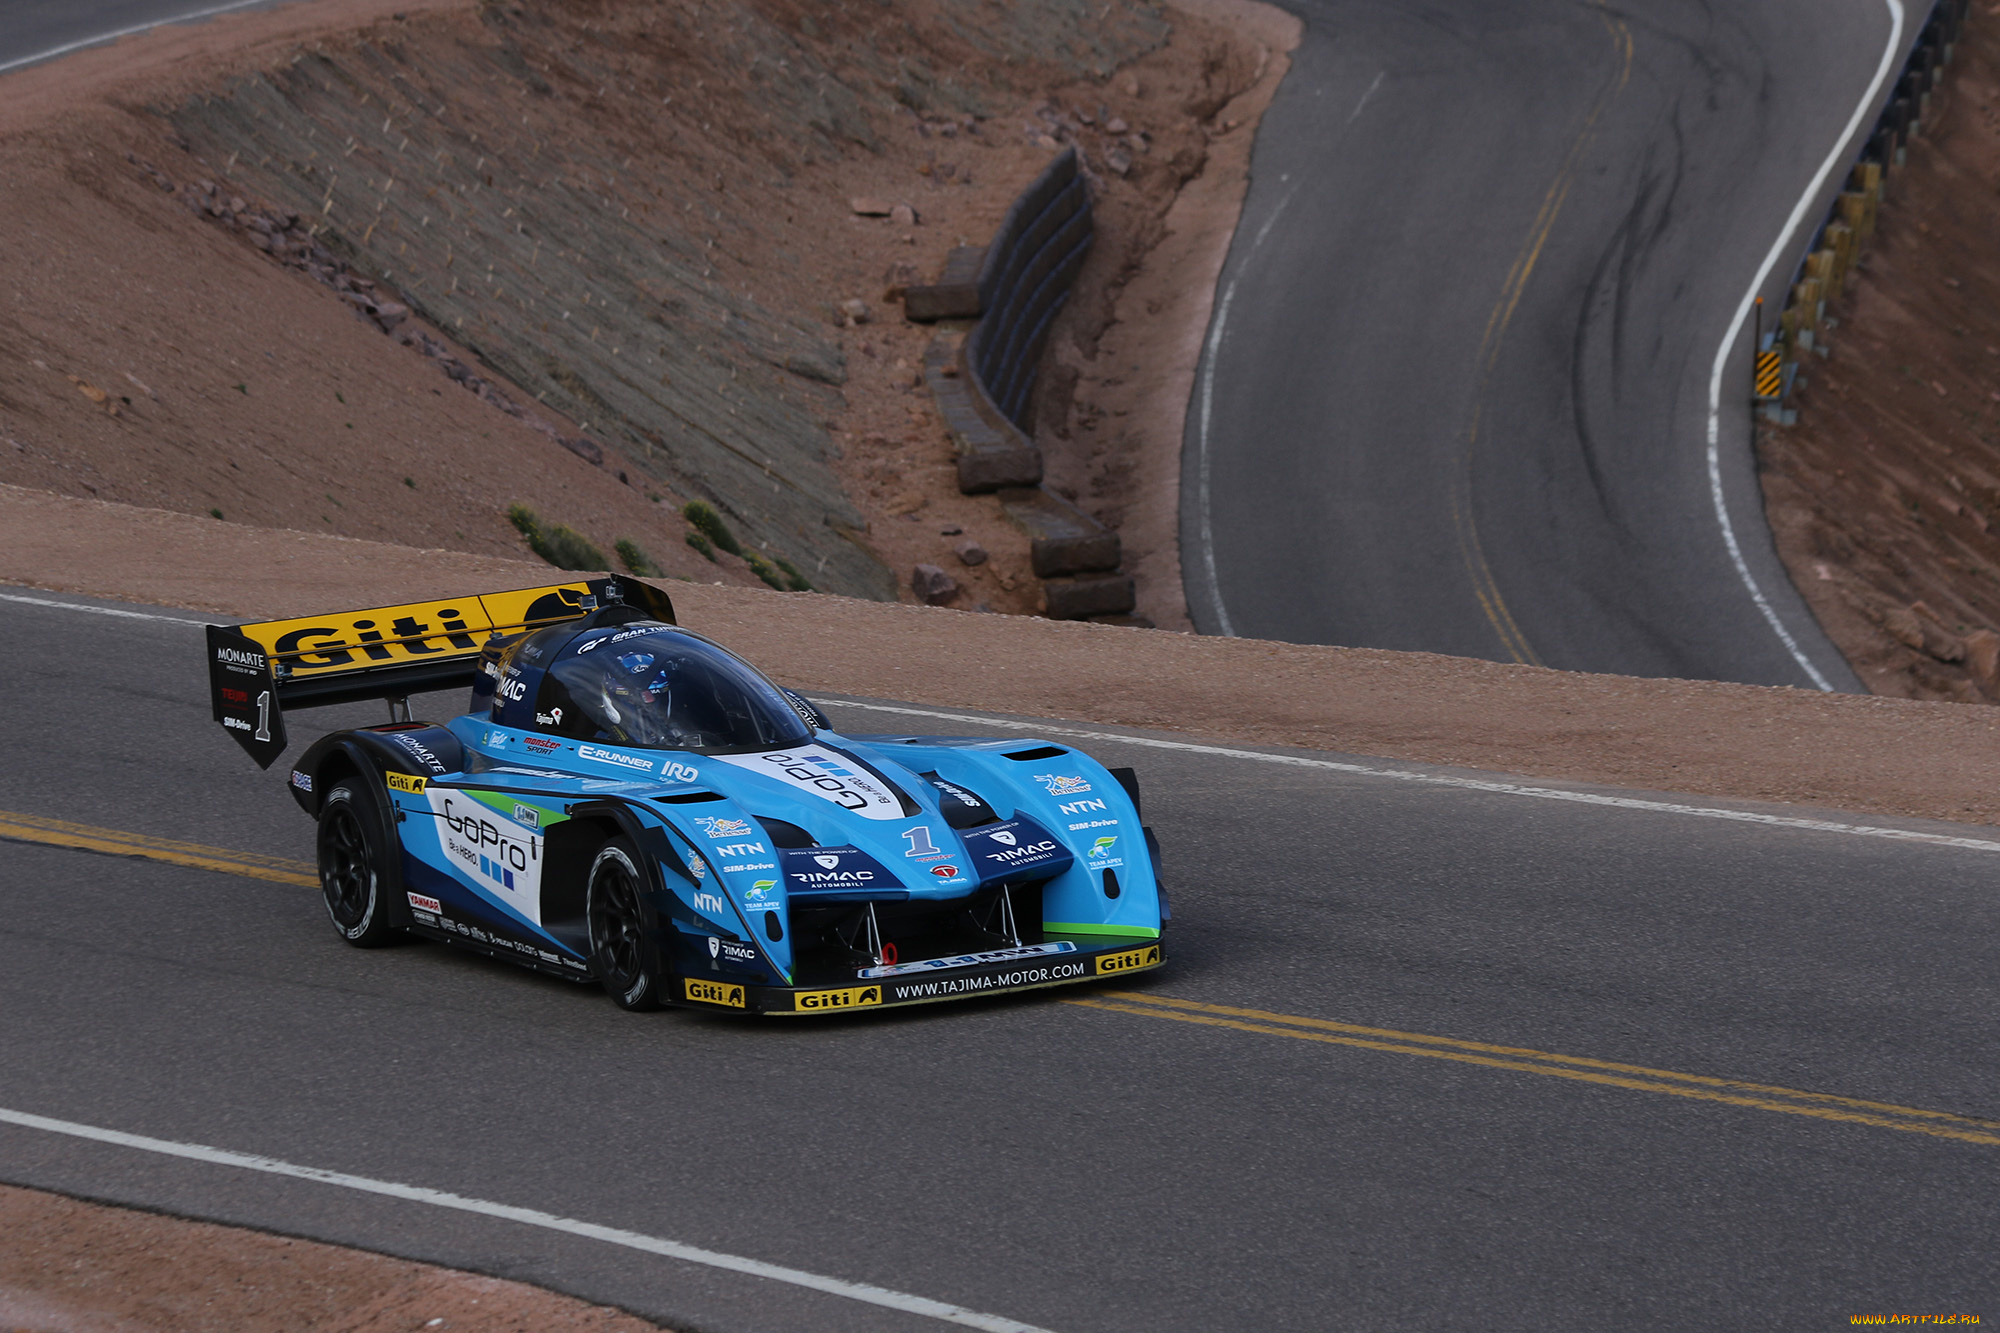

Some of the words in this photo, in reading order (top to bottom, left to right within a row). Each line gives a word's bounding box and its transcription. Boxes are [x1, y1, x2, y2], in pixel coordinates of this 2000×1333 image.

[274, 608, 478, 669] Giti
[612, 628, 646, 641] GRAN
[217, 647, 265, 668] MONARTE
[255, 690, 271, 742] 1
[523, 737, 562, 750] monster
[526, 745, 554, 756] SPORT
[392, 733, 447, 773] MONARTE
[578, 744, 654, 769] E-RUNNER
[660, 760, 699, 783] IRD
[389, 775, 409, 790] Giti
[762, 754, 868, 810] GoPro
[1051, 784, 1091, 796] Benesse
[1058, 798, 1107, 816] NTN
[709, 828, 751, 838] Benesse
[1068, 819, 1118, 832] SIM-Drive
[444, 798, 526, 872] GoPro
[902, 826, 941, 857] 1
[716, 842, 766, 857] NTN
[986, 840, 1056, 862] RIMAC
[723, 863, 774, 873] SIM-Drive
[1010, 852, 1053, 866] AUTOMOBILI
[790, 871, 874, 882] RIMAC
[410, 894, 440, 912] YANMAR
[694, 892, 722, 914] NTN
[722, 945, 755, 959] RIMAC
[1100, 952, 1141, 971] Giti
[895, 962, 1085, 999] WWW.TAJIMA-MOTOR.COM
[689, 982, 723, 1002] Giti
[799, 992, 850, 1008] Giti
